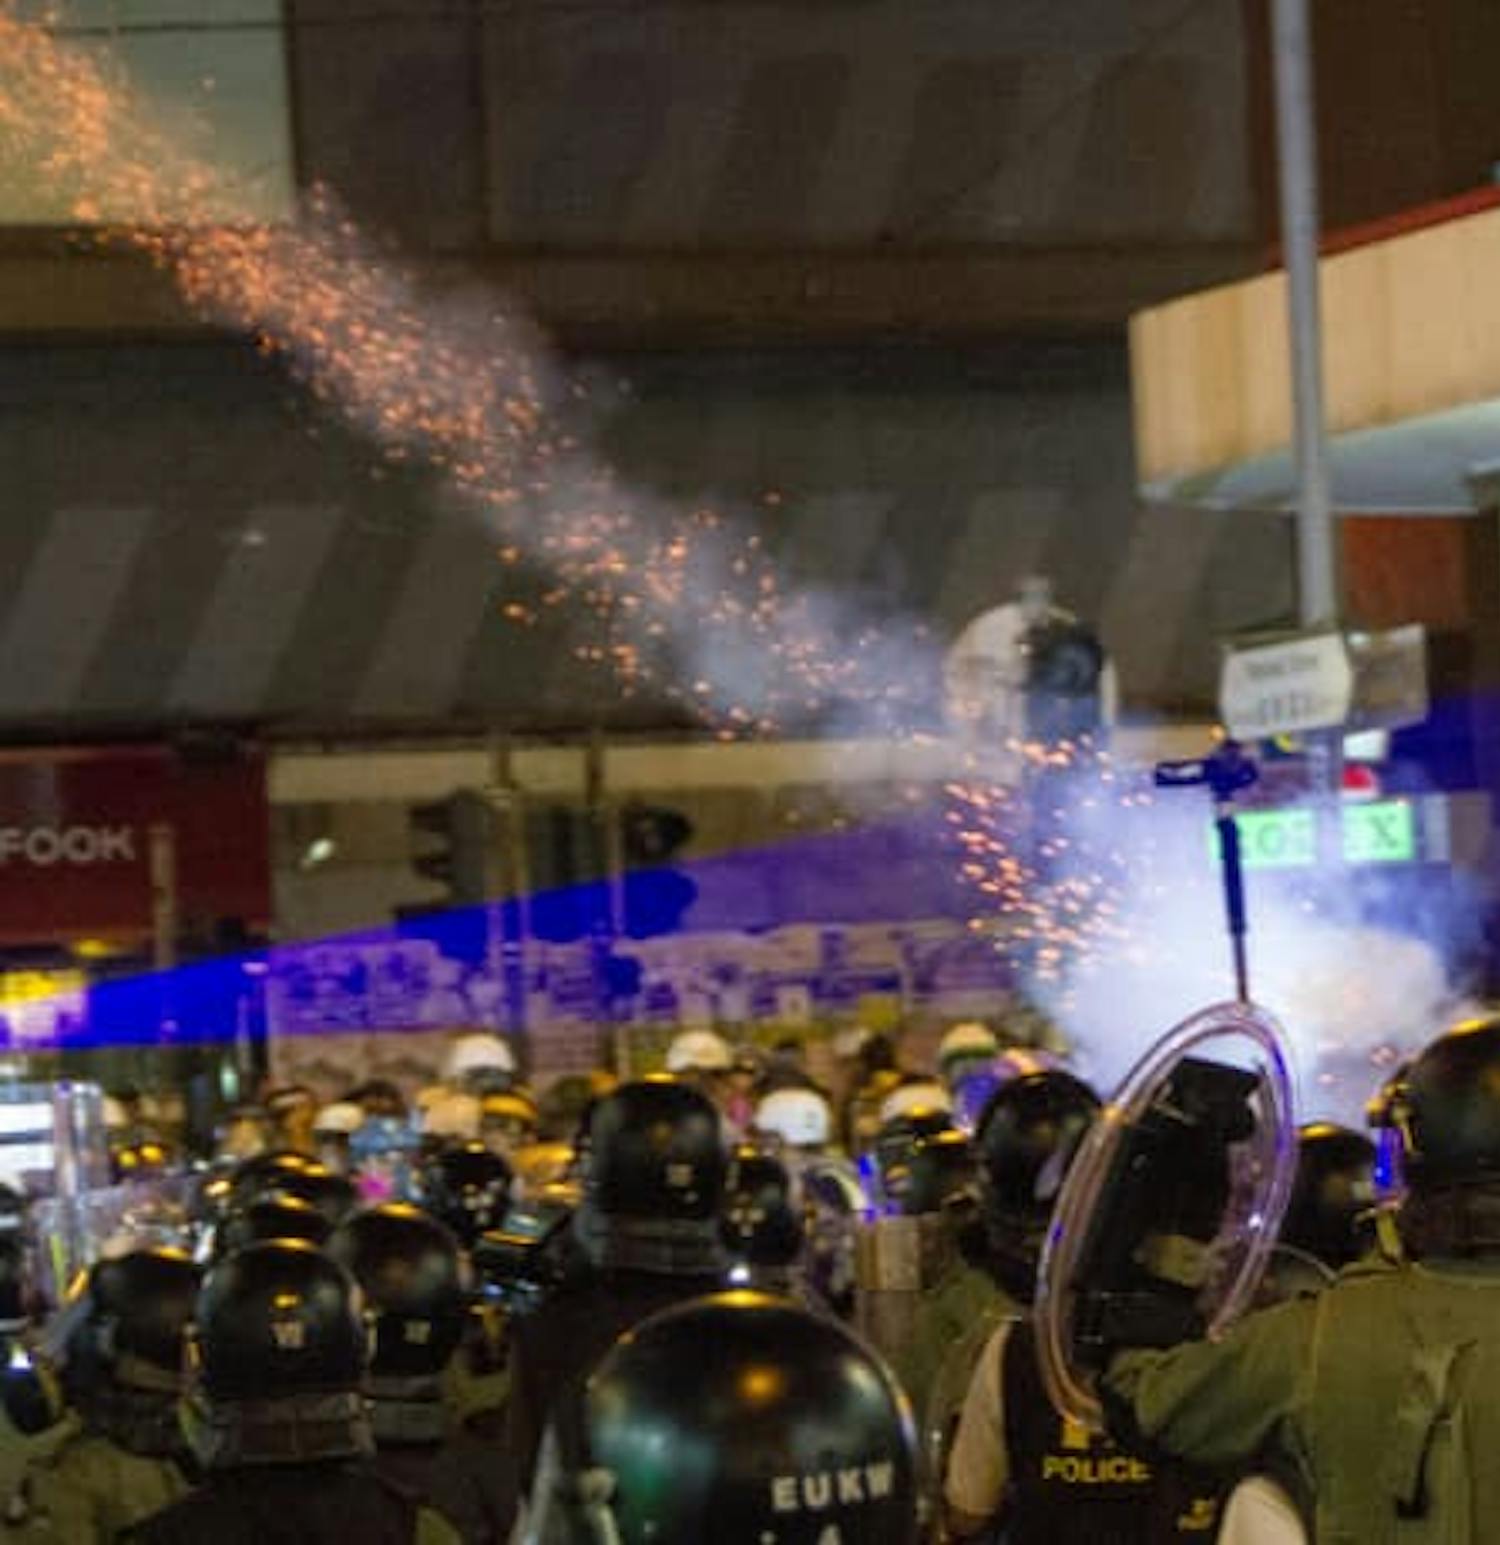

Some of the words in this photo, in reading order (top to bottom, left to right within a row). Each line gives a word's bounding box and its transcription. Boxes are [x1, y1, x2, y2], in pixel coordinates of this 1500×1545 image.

[0, 825, 137, 865] FOOK
[771, 1461, 895, 1512] EUKW
[1042, 1456, 1153, 1484] POLICE
